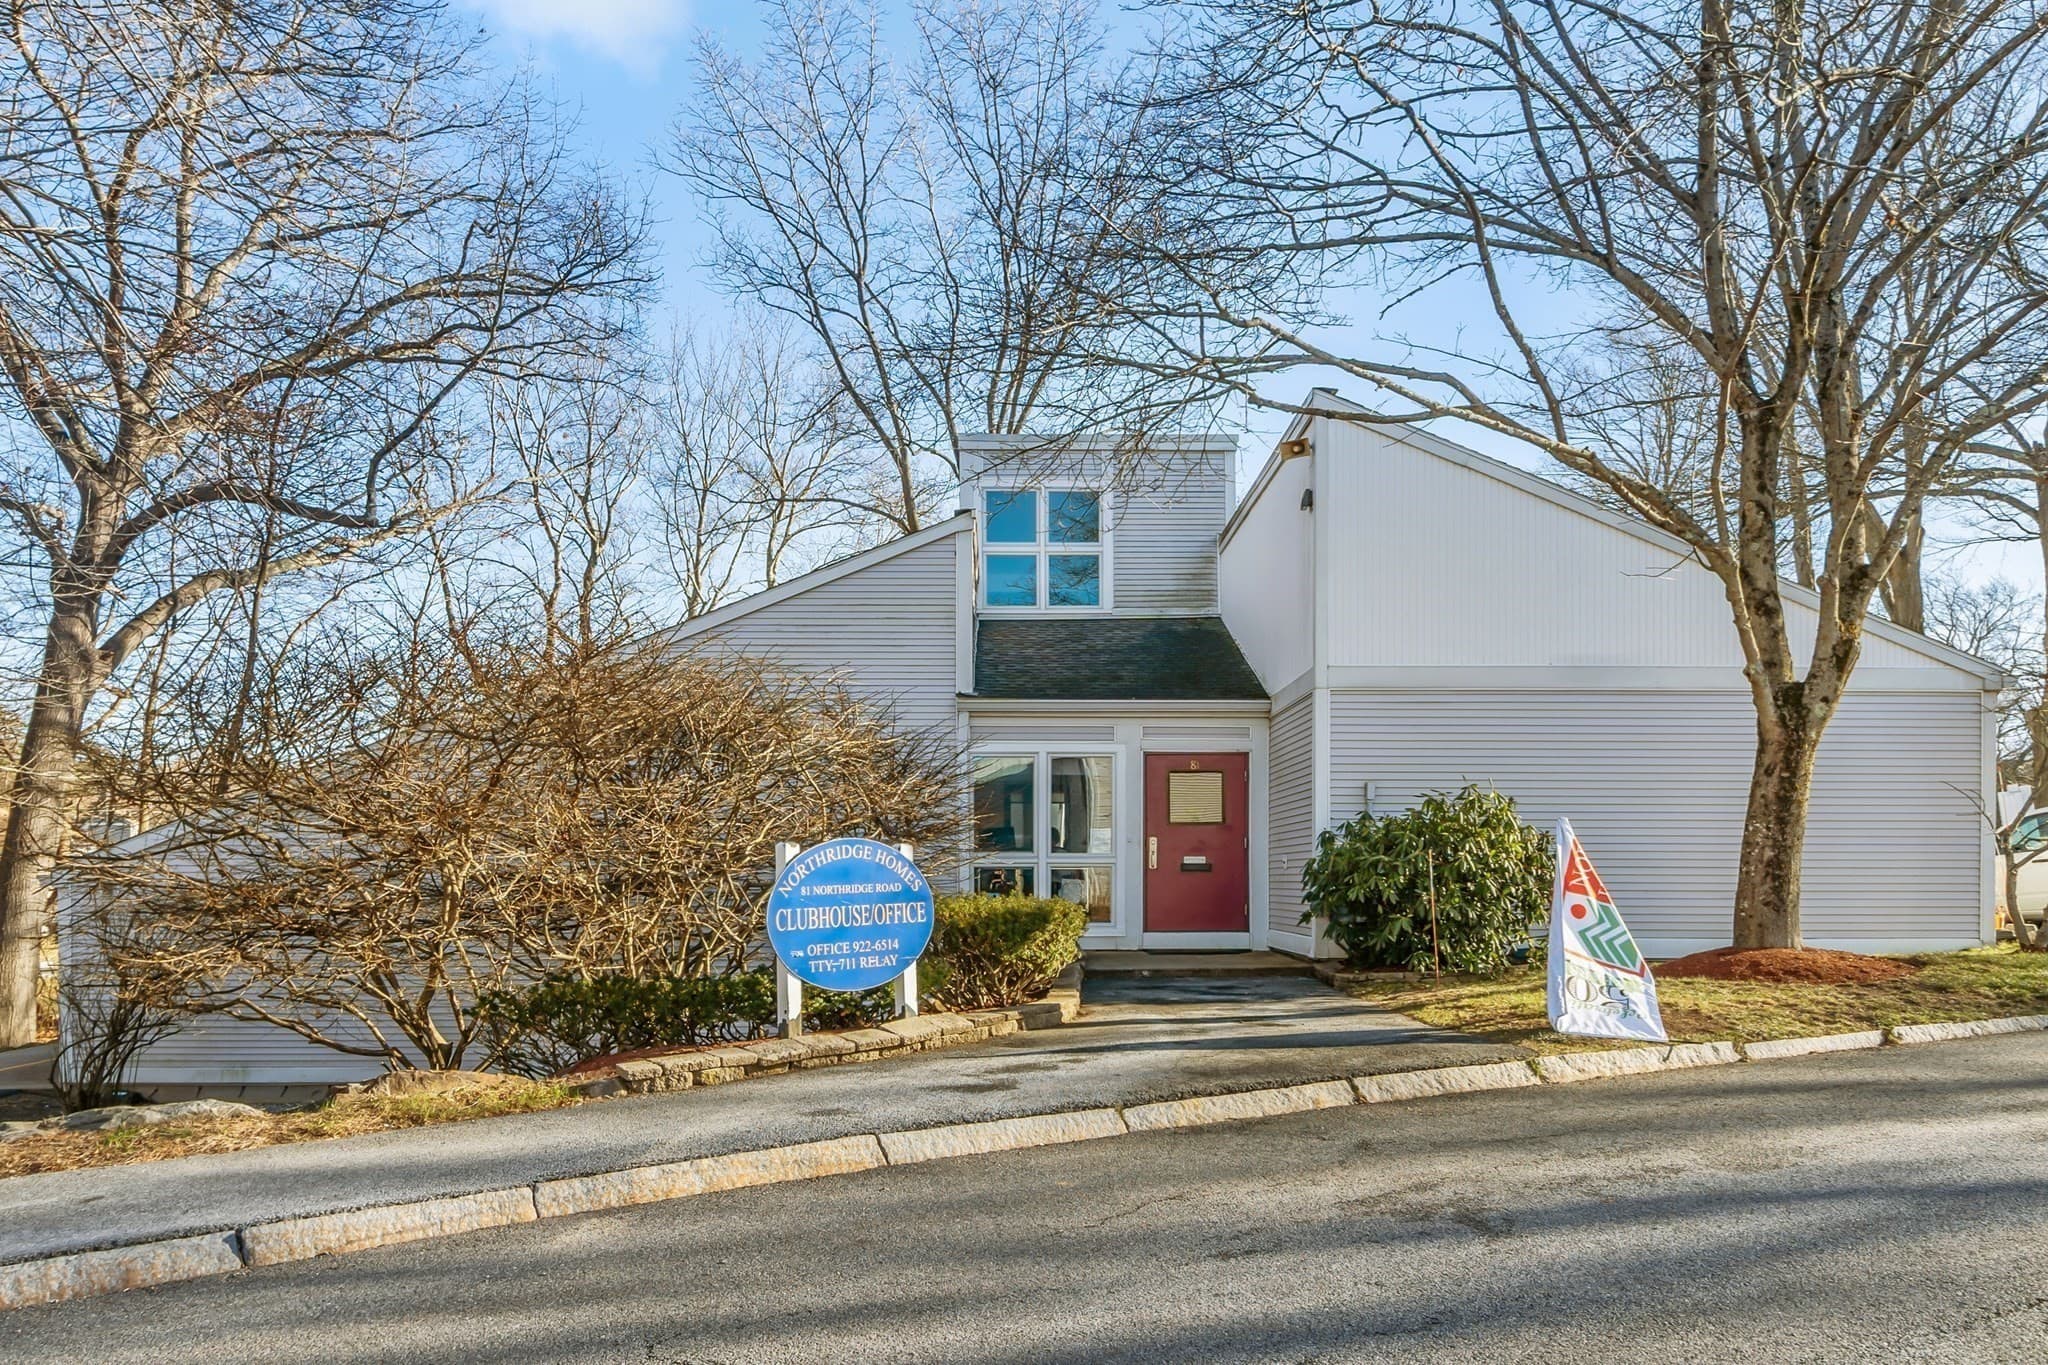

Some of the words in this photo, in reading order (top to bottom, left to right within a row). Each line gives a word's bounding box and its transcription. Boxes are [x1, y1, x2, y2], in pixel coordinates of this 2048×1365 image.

[778, 844, 873, 898] NORTHRIDGE
[875, 849, 922, 892] HOMES
[800, 885, 810, 896] 81
[813, 884, 873, 895] NORTHRIDGE
[875, 882, 902, 893] ROAD
[807, 942, 850, 957] OFFICE
[852, 938, 899, 952] 922-6514
[860, 954, 898, 968] RELAY
